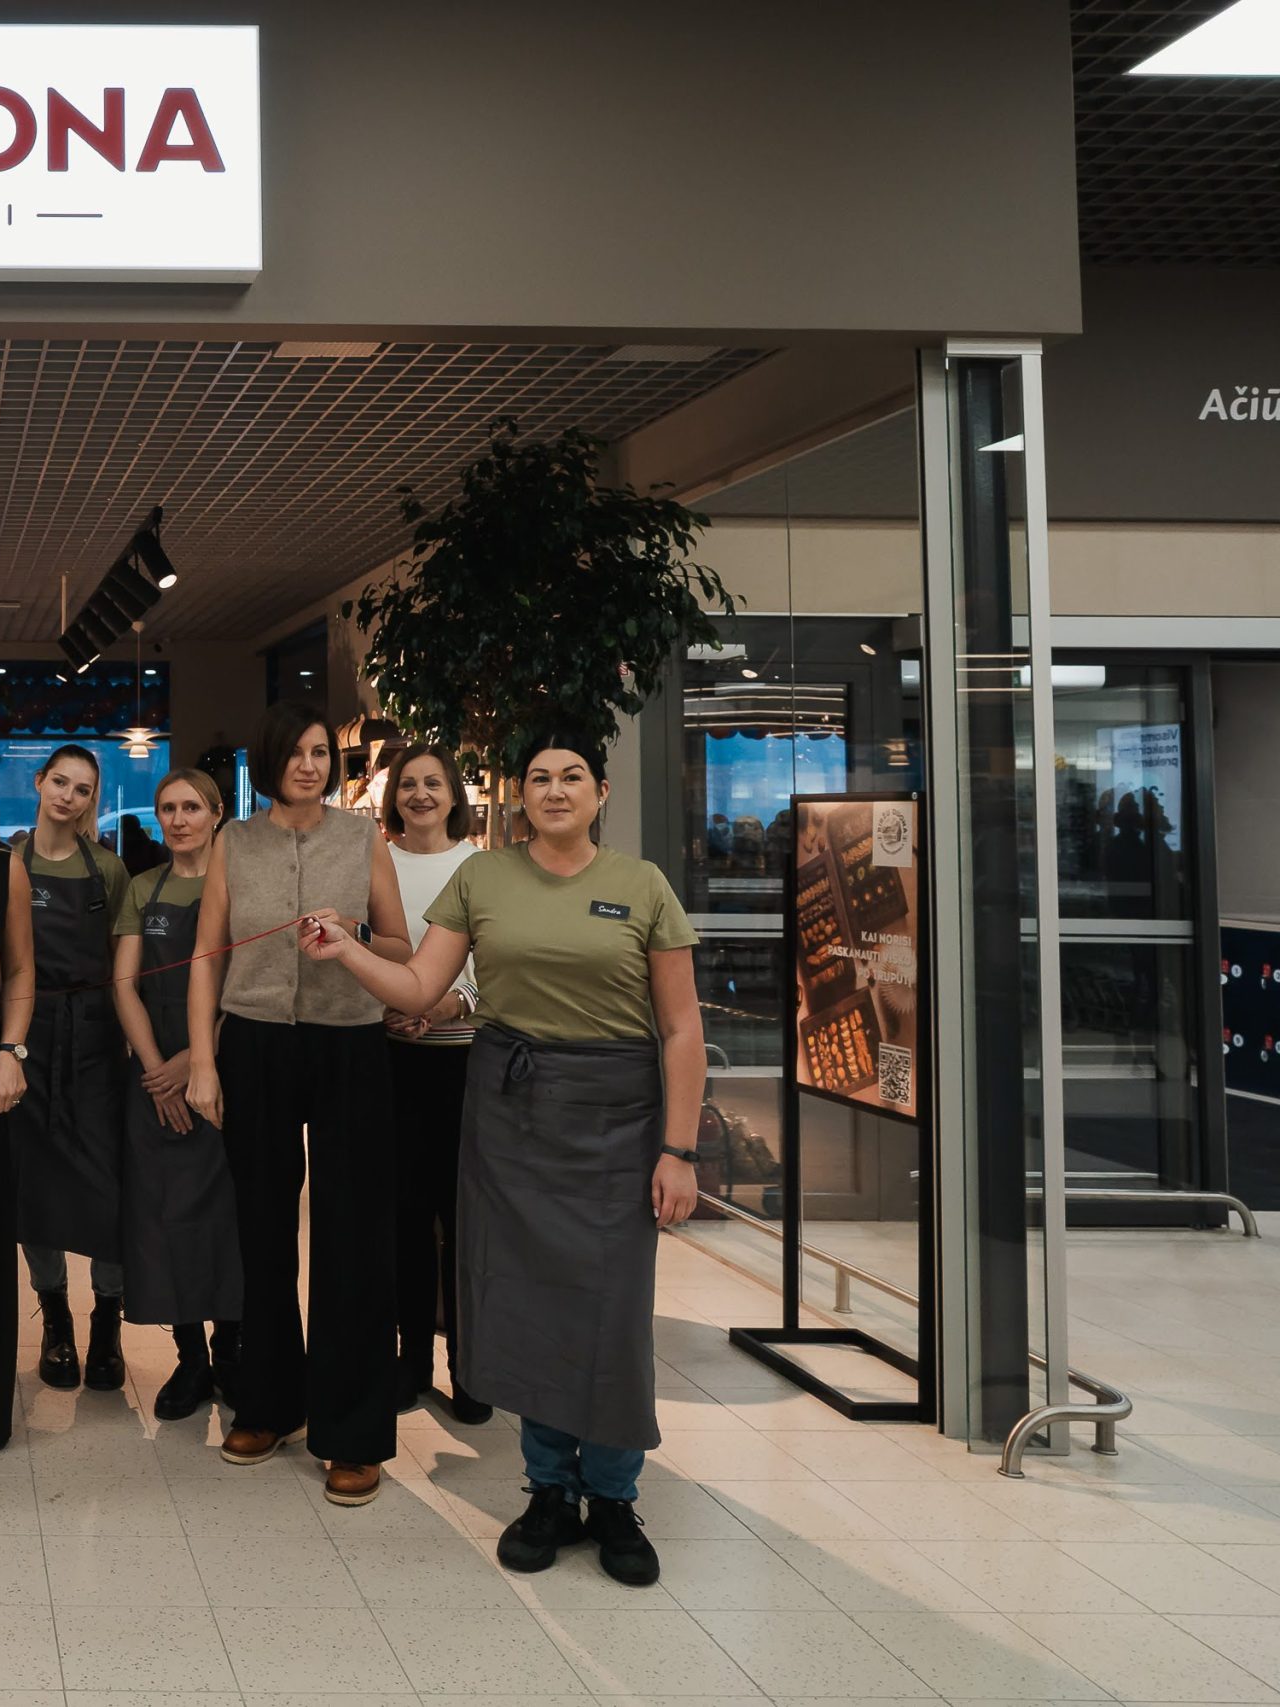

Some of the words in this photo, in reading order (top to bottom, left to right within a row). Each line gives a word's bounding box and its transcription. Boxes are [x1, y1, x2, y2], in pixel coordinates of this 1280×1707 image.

[598, 905, 621, 915] Sandra
[861, 931, 877, 943] KAI
[827, 944, 881, 962] PASKANAUTI
